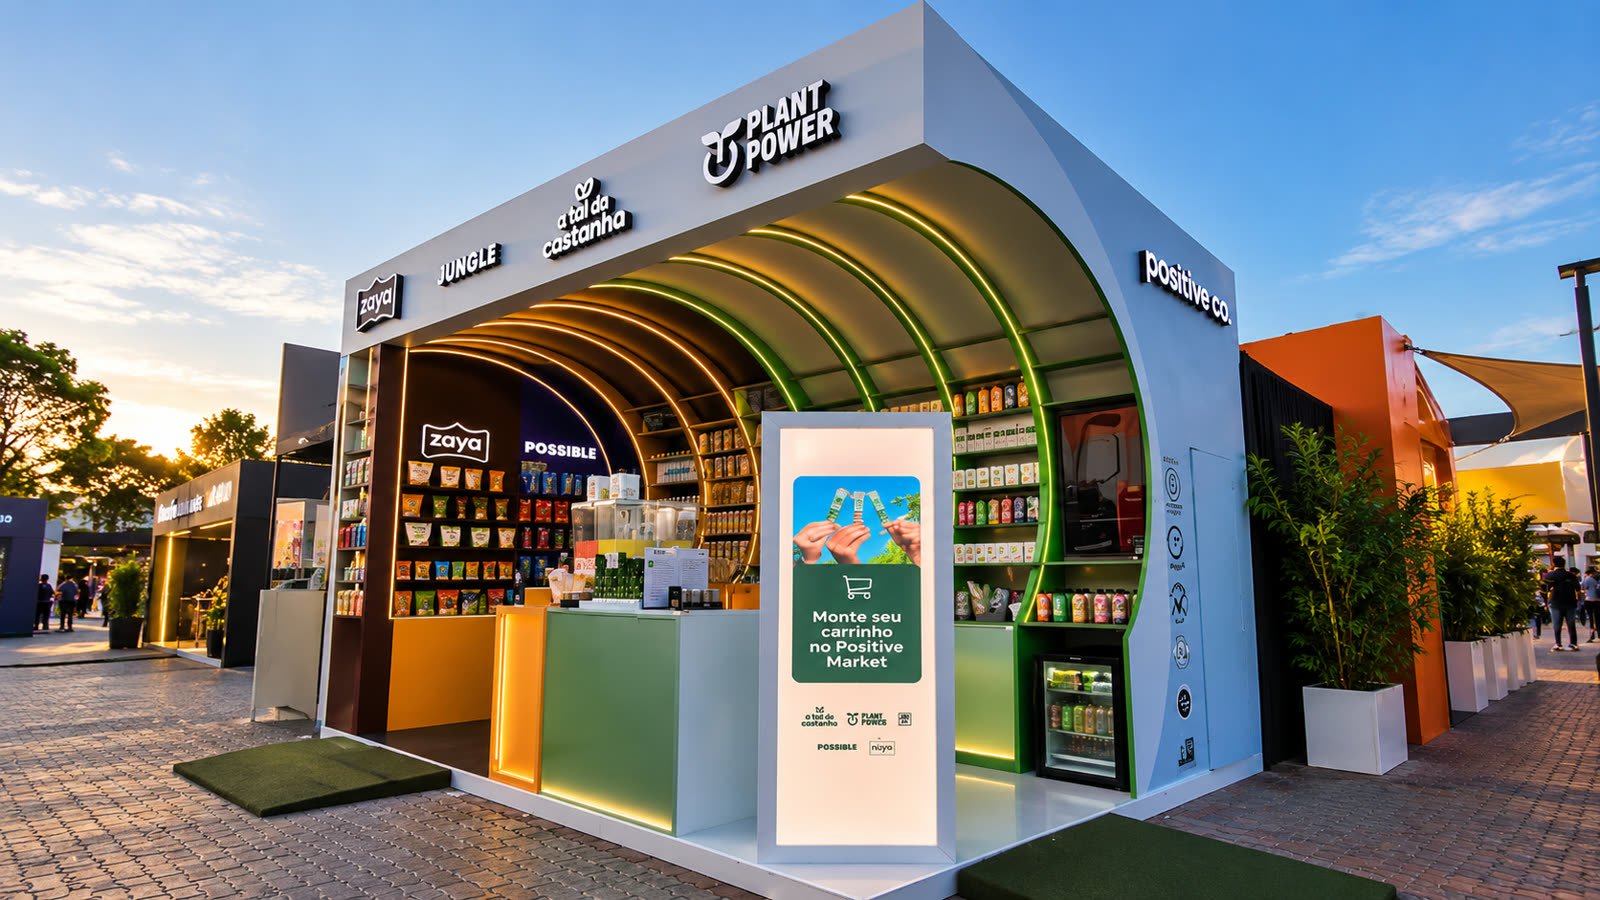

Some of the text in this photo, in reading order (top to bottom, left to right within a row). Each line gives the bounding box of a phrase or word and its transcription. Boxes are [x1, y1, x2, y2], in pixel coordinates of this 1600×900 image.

[746, 79, 826, 139] PLANT
[746, 107, 836, 170] POWER
[557, 194, 610, 230] a tal da
[542, 210, 627, 259] castanha
[437, 243, 498, 286] JUNGLE
[360, 287, 393, 315] zaya
[1144, 249, 1232, 325] positive co.
[429, 433, 482, 453] zaya
[524, 441, 597, 460] POSSIBLE
[812, 610, 902, 623] Monte seu
[821, 625, 893, 638] carrinho
[809, 640, 904, 653] no Positive
[826, 655, 888, 668] Market
